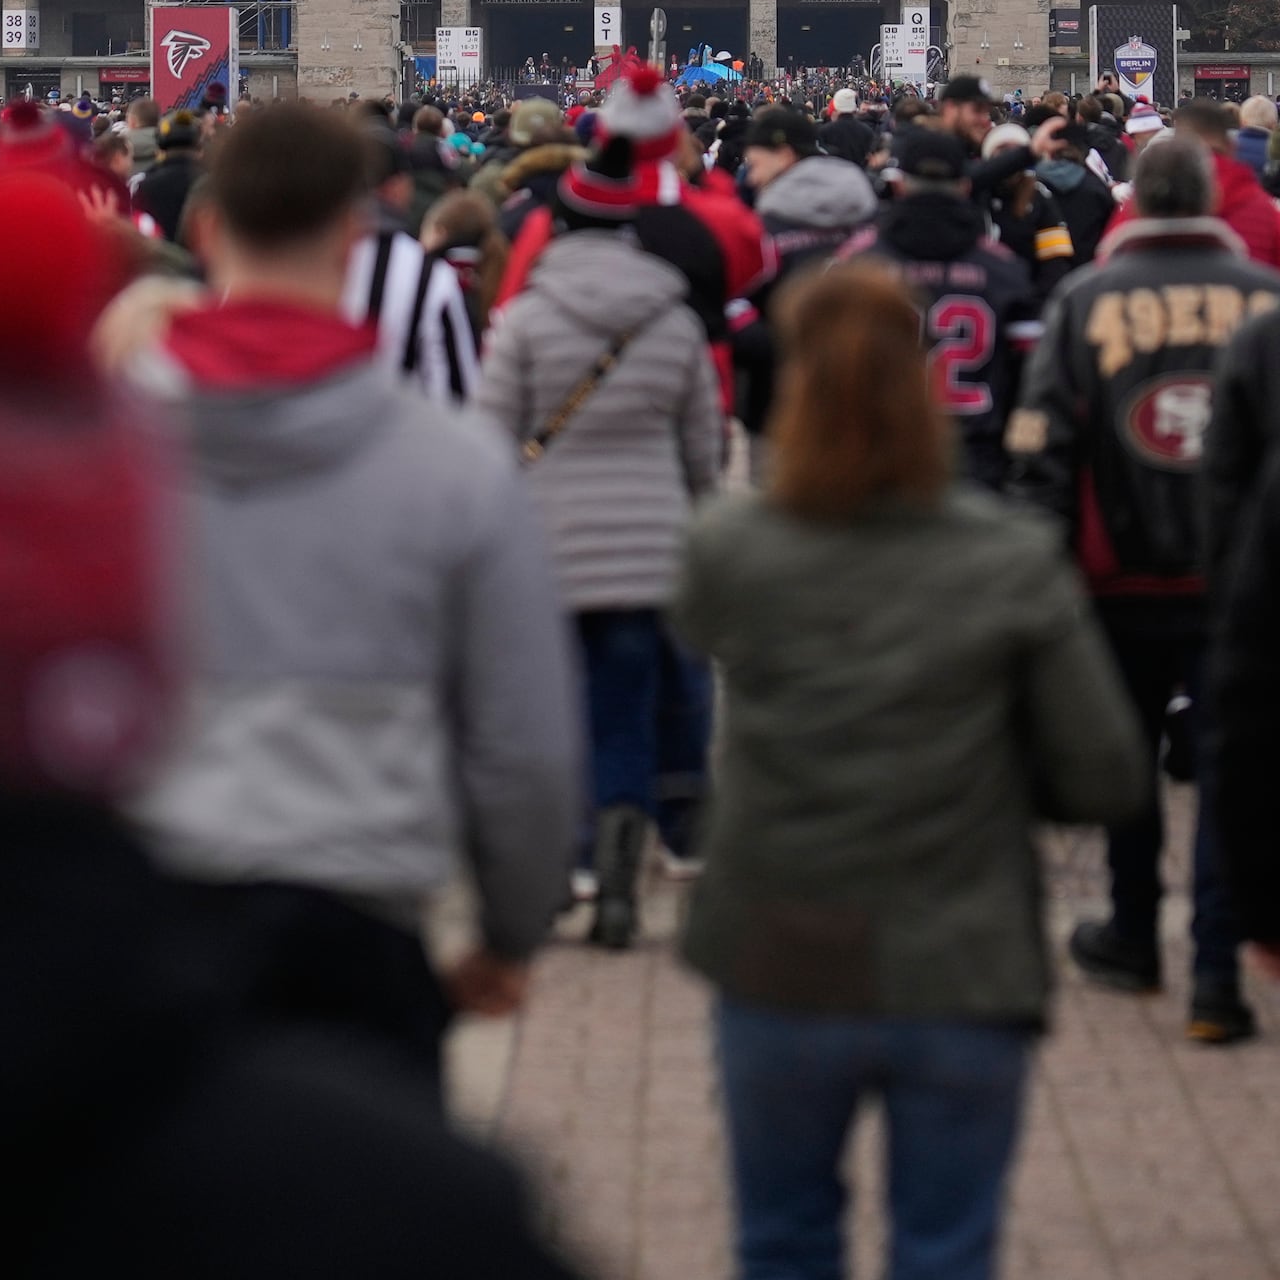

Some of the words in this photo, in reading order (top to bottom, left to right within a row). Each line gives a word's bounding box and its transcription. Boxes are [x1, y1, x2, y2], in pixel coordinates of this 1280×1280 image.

[5, 15, 23, 27] 38
[28, 15, 37, 28] 38
[601, 12, 611, 24] S
[911, 12, 923, 25] Q
[5, 31, 22, 43] 39
[28, 31, 37, 45] 39
[601, 29, 611, 41] T
